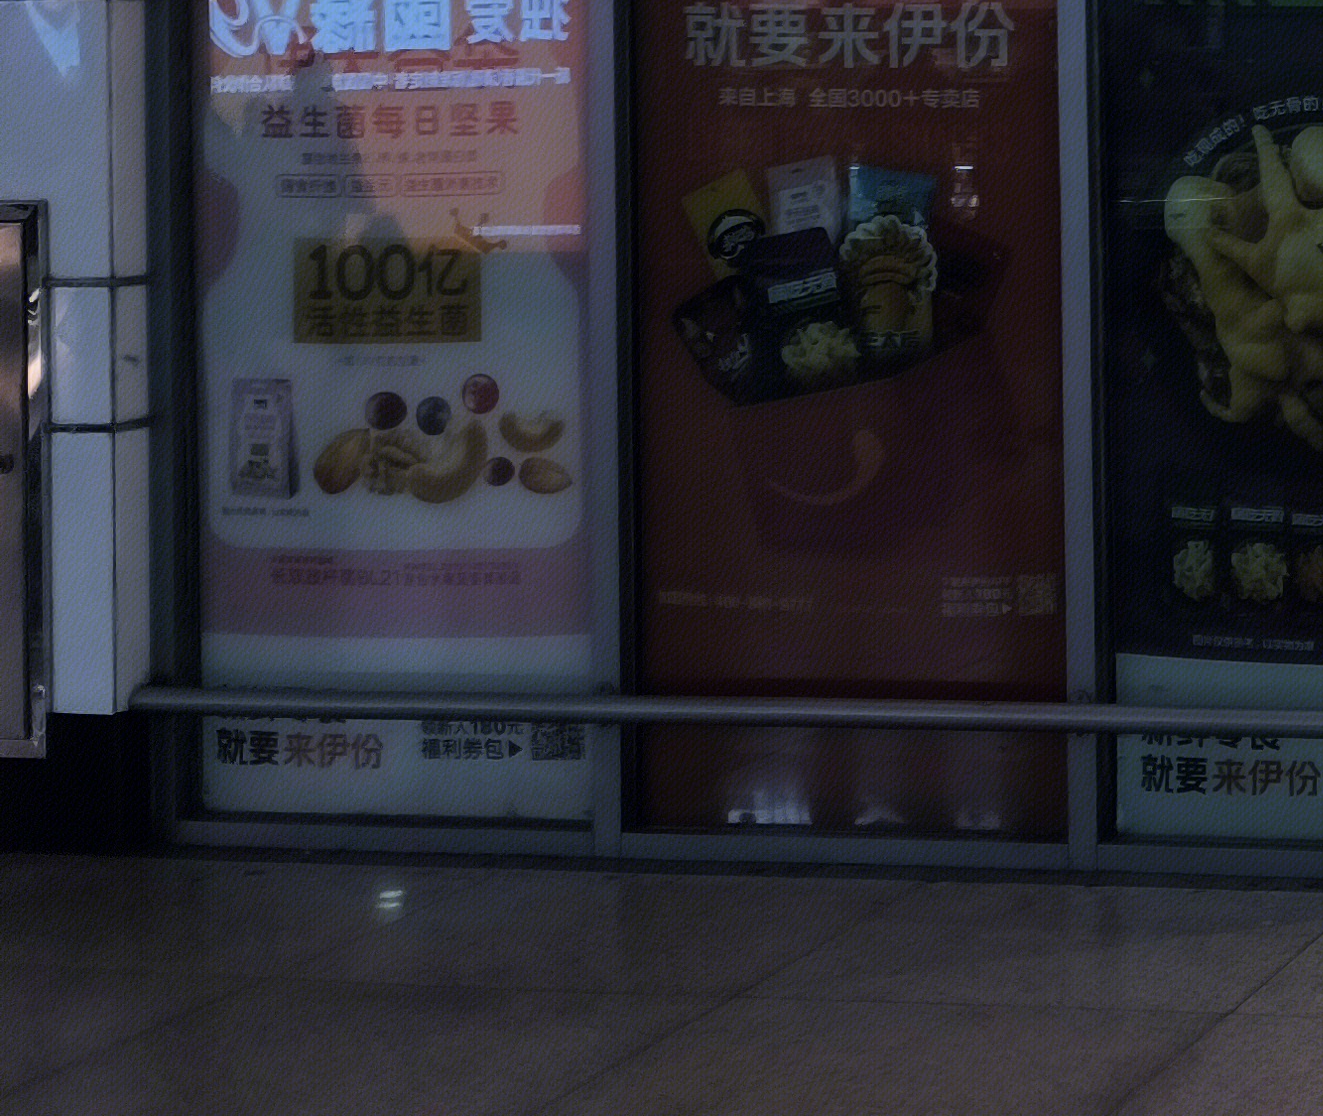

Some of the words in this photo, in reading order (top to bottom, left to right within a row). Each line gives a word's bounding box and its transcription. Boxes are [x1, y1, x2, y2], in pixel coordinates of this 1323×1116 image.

[683, 0, 1016, 70] 就要来伊份
[261, 99, 519, 140] 益生菌每日坚果
[309, 243, 470, 301] 100亿
[215, 728, 384, 770] 就要来伊份
[1140, 754, 1322, 797] 就要来伊份
